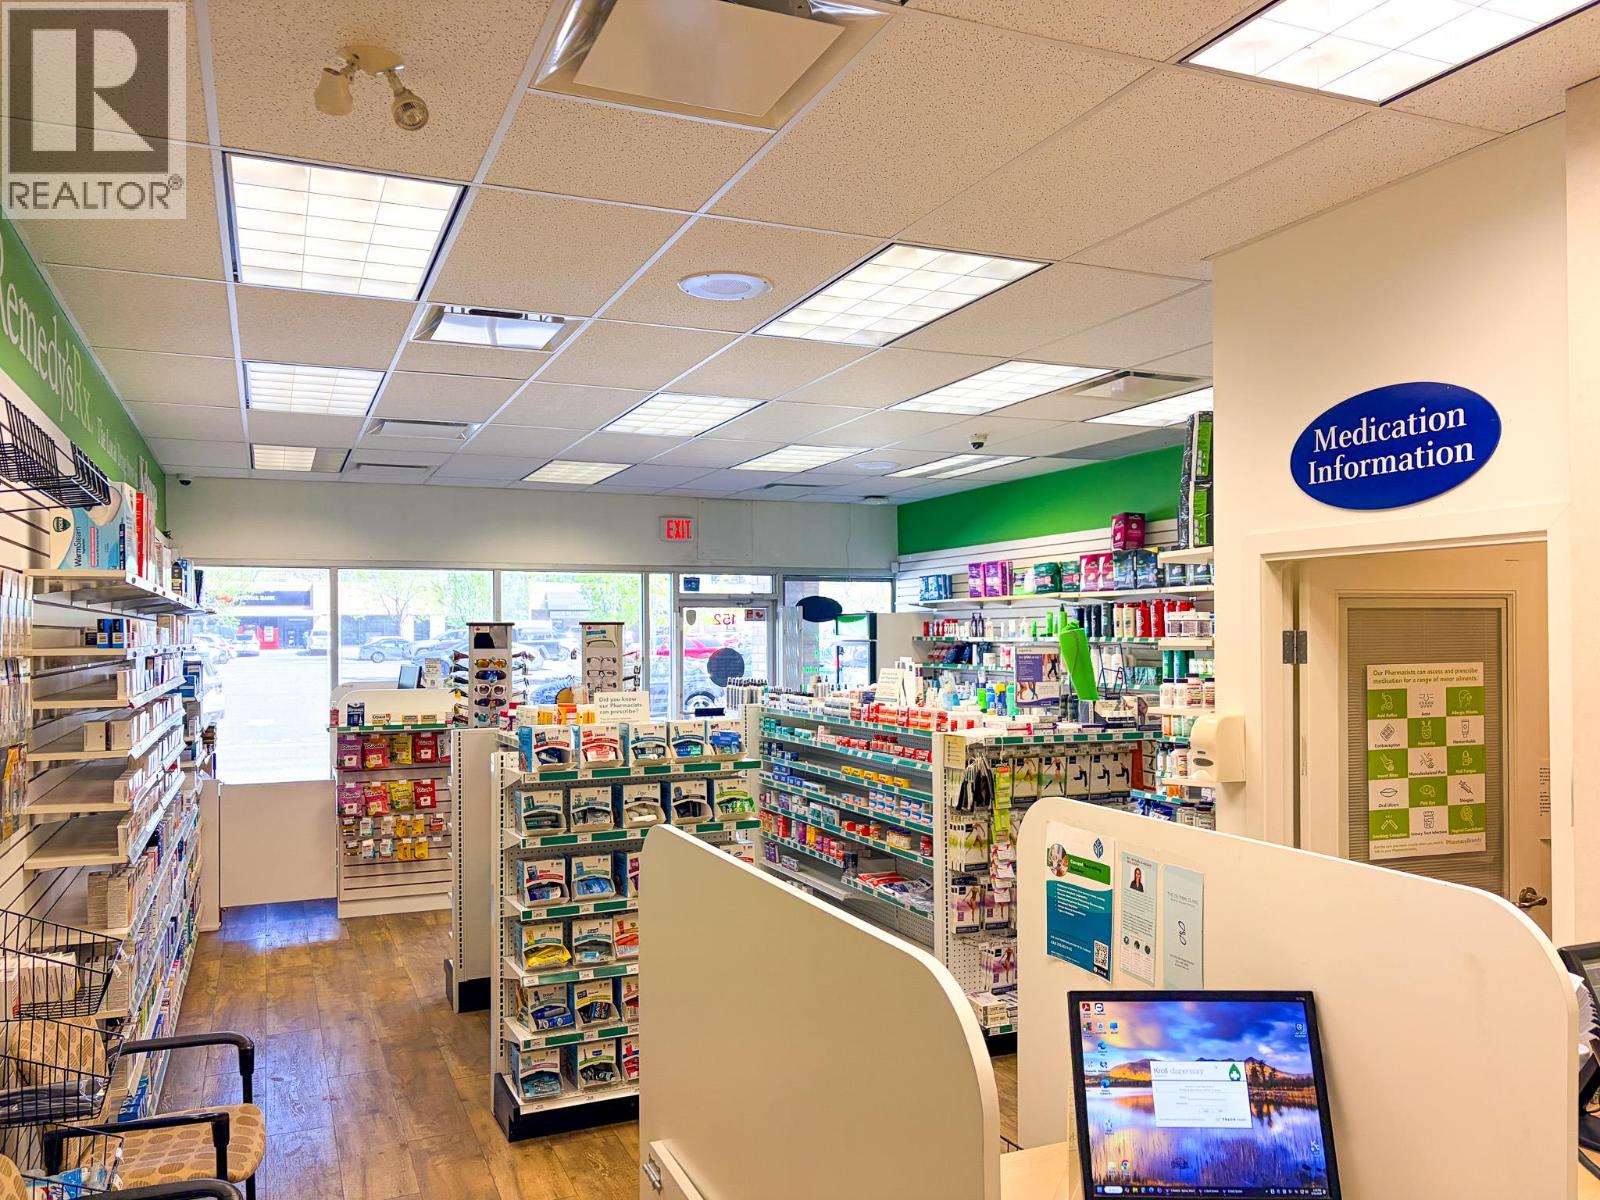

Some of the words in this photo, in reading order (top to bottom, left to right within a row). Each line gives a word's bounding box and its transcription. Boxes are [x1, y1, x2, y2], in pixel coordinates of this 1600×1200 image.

[1313, 407, 1467, 453] Medication
[1307, 440, 1475, 485] Information
[666, 519, 691, 540] EXIT
